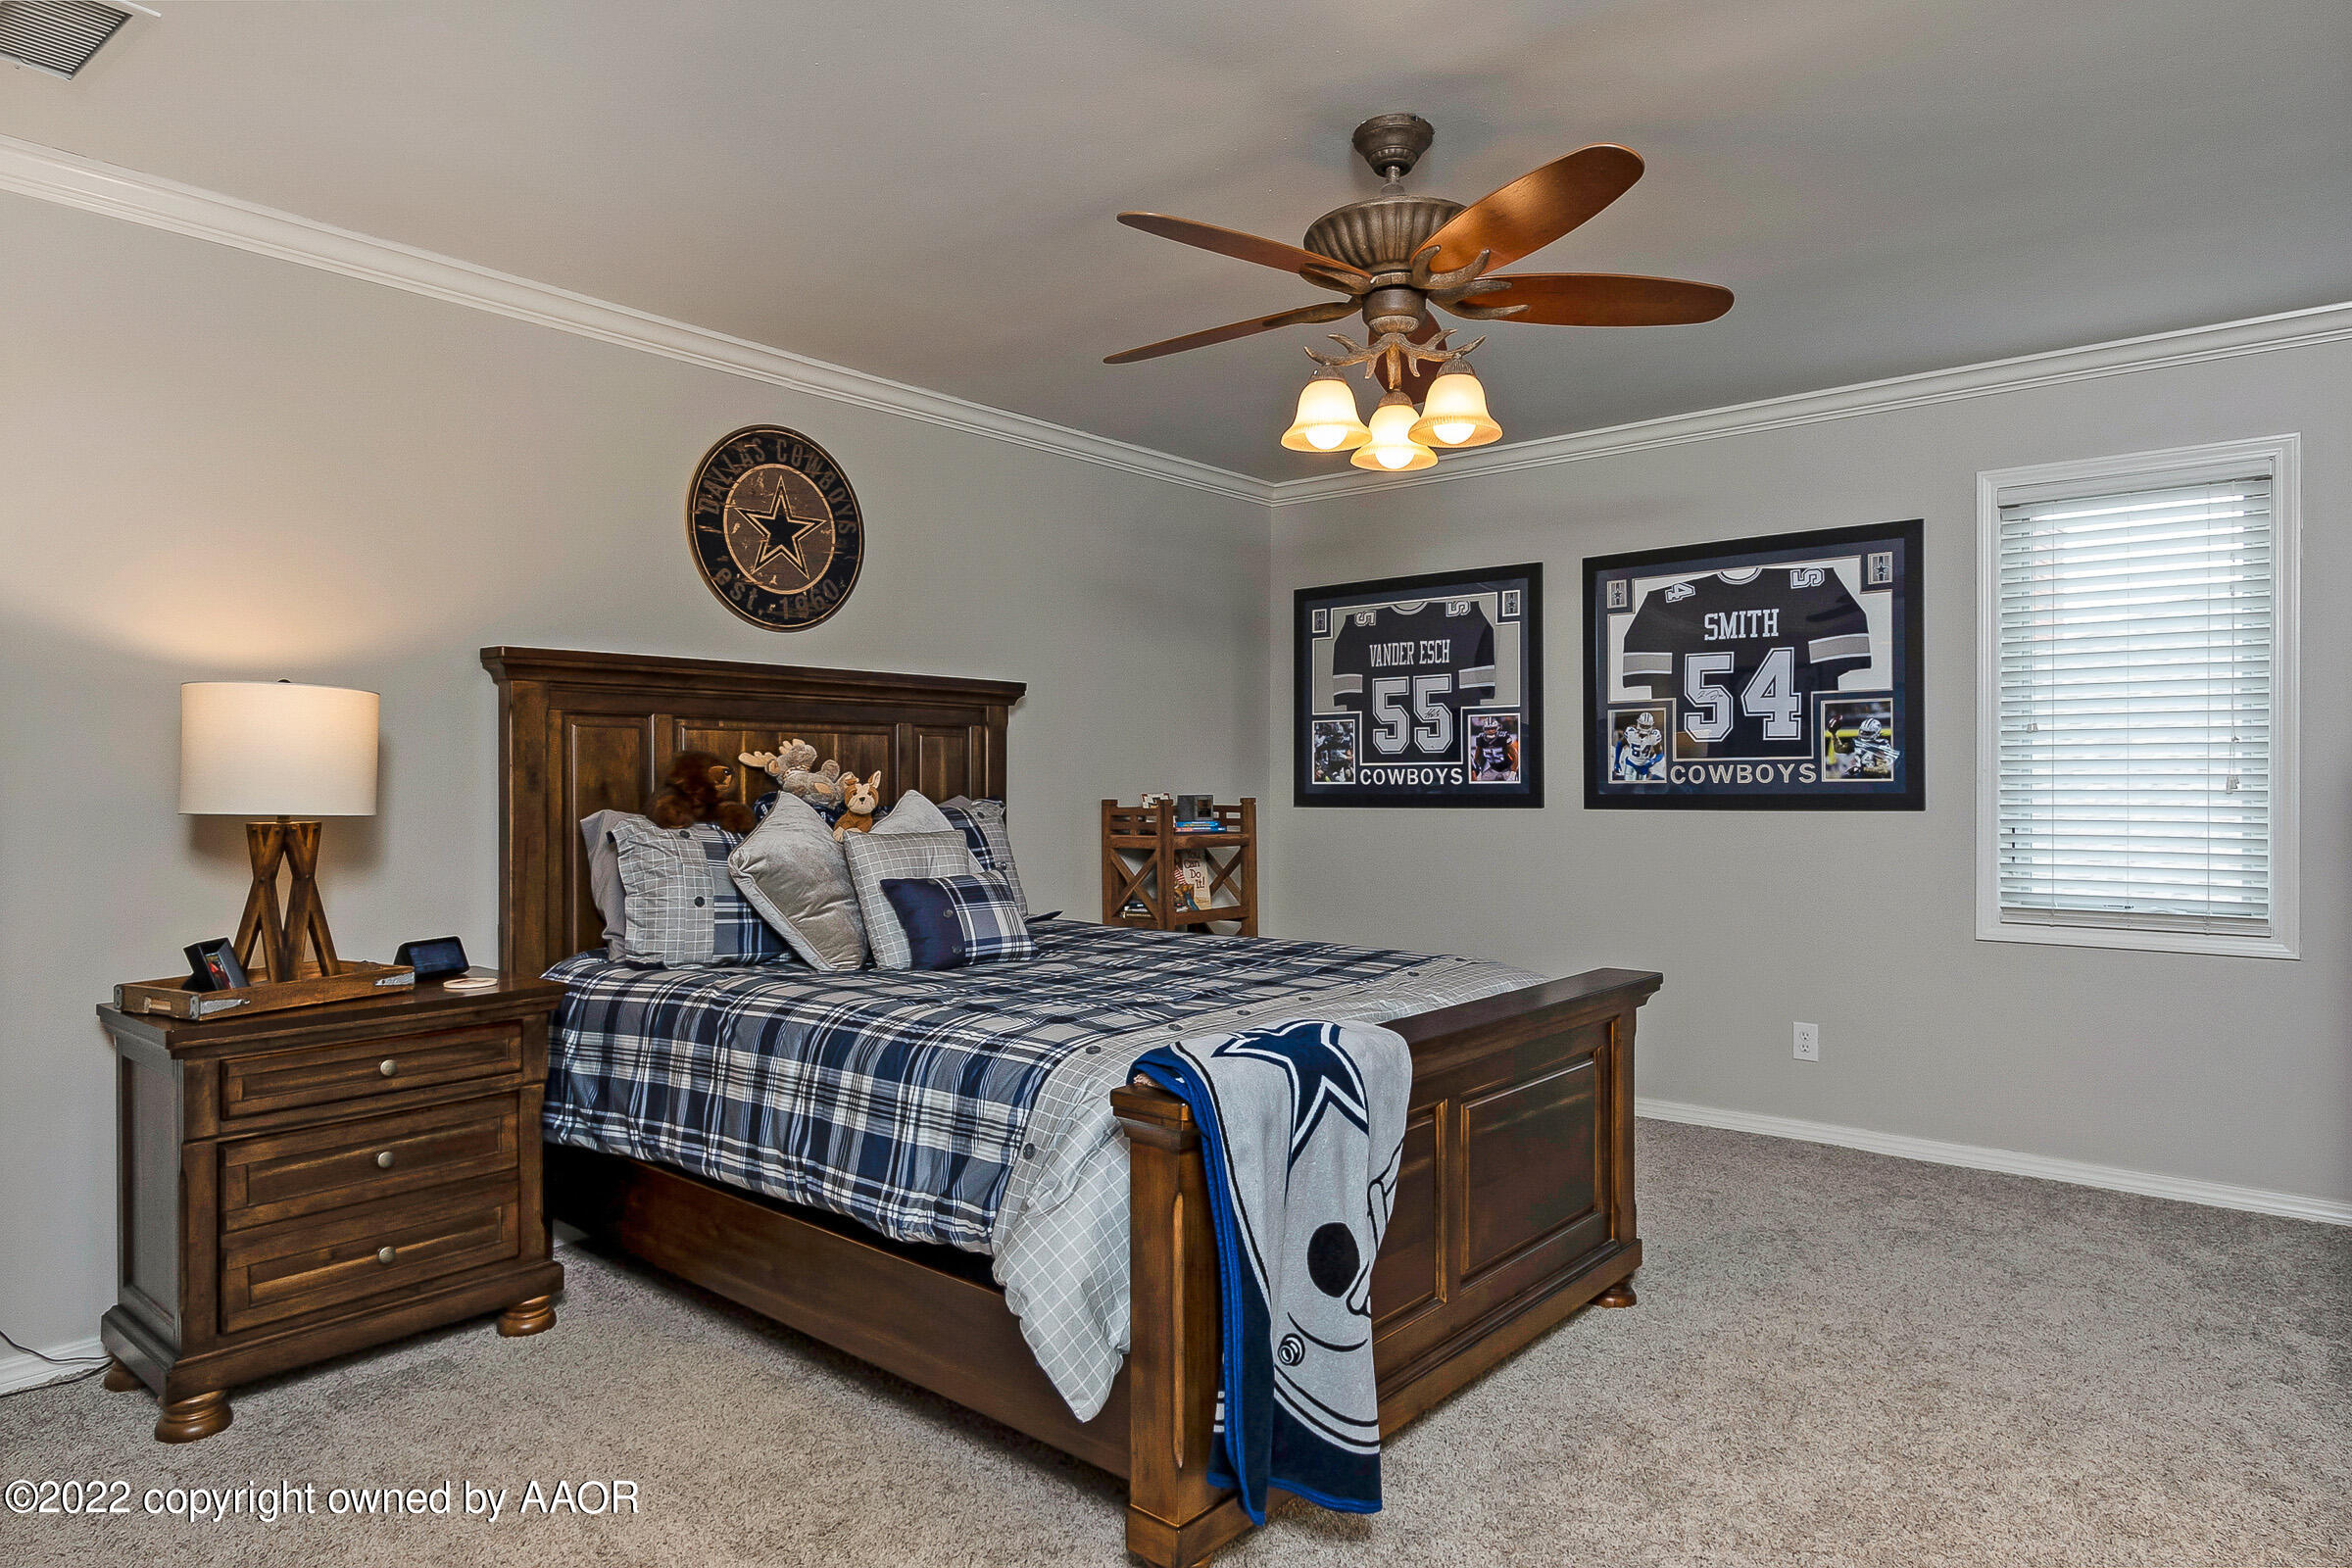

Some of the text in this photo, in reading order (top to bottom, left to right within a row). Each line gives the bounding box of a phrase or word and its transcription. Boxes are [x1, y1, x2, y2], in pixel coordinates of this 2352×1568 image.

[697, 437, 858, 535] DALLAS COWBOYS
[1789, 566, 1826, 589] 5
[778, 578, 839, 620] 1960
[1446, 601, 1470, 617] 5
[1703, 608, 1780, 641] SMITH
[1369, 639, 1451, 667] VANDER ESCH
[1684, 646, 1801, 743] 54
[1372, 673, 1453, 755] 55
[1482, 747, 1504, 763] 55
[1359, 766, 1464, 786] COWBOYS
[1669, 763, 1817, 785] COWBOYS
[1183, 858, 1200, 868] Can
[1189, 868, 1201, 879] Do
[1195, 876, 1205, 889] It!
